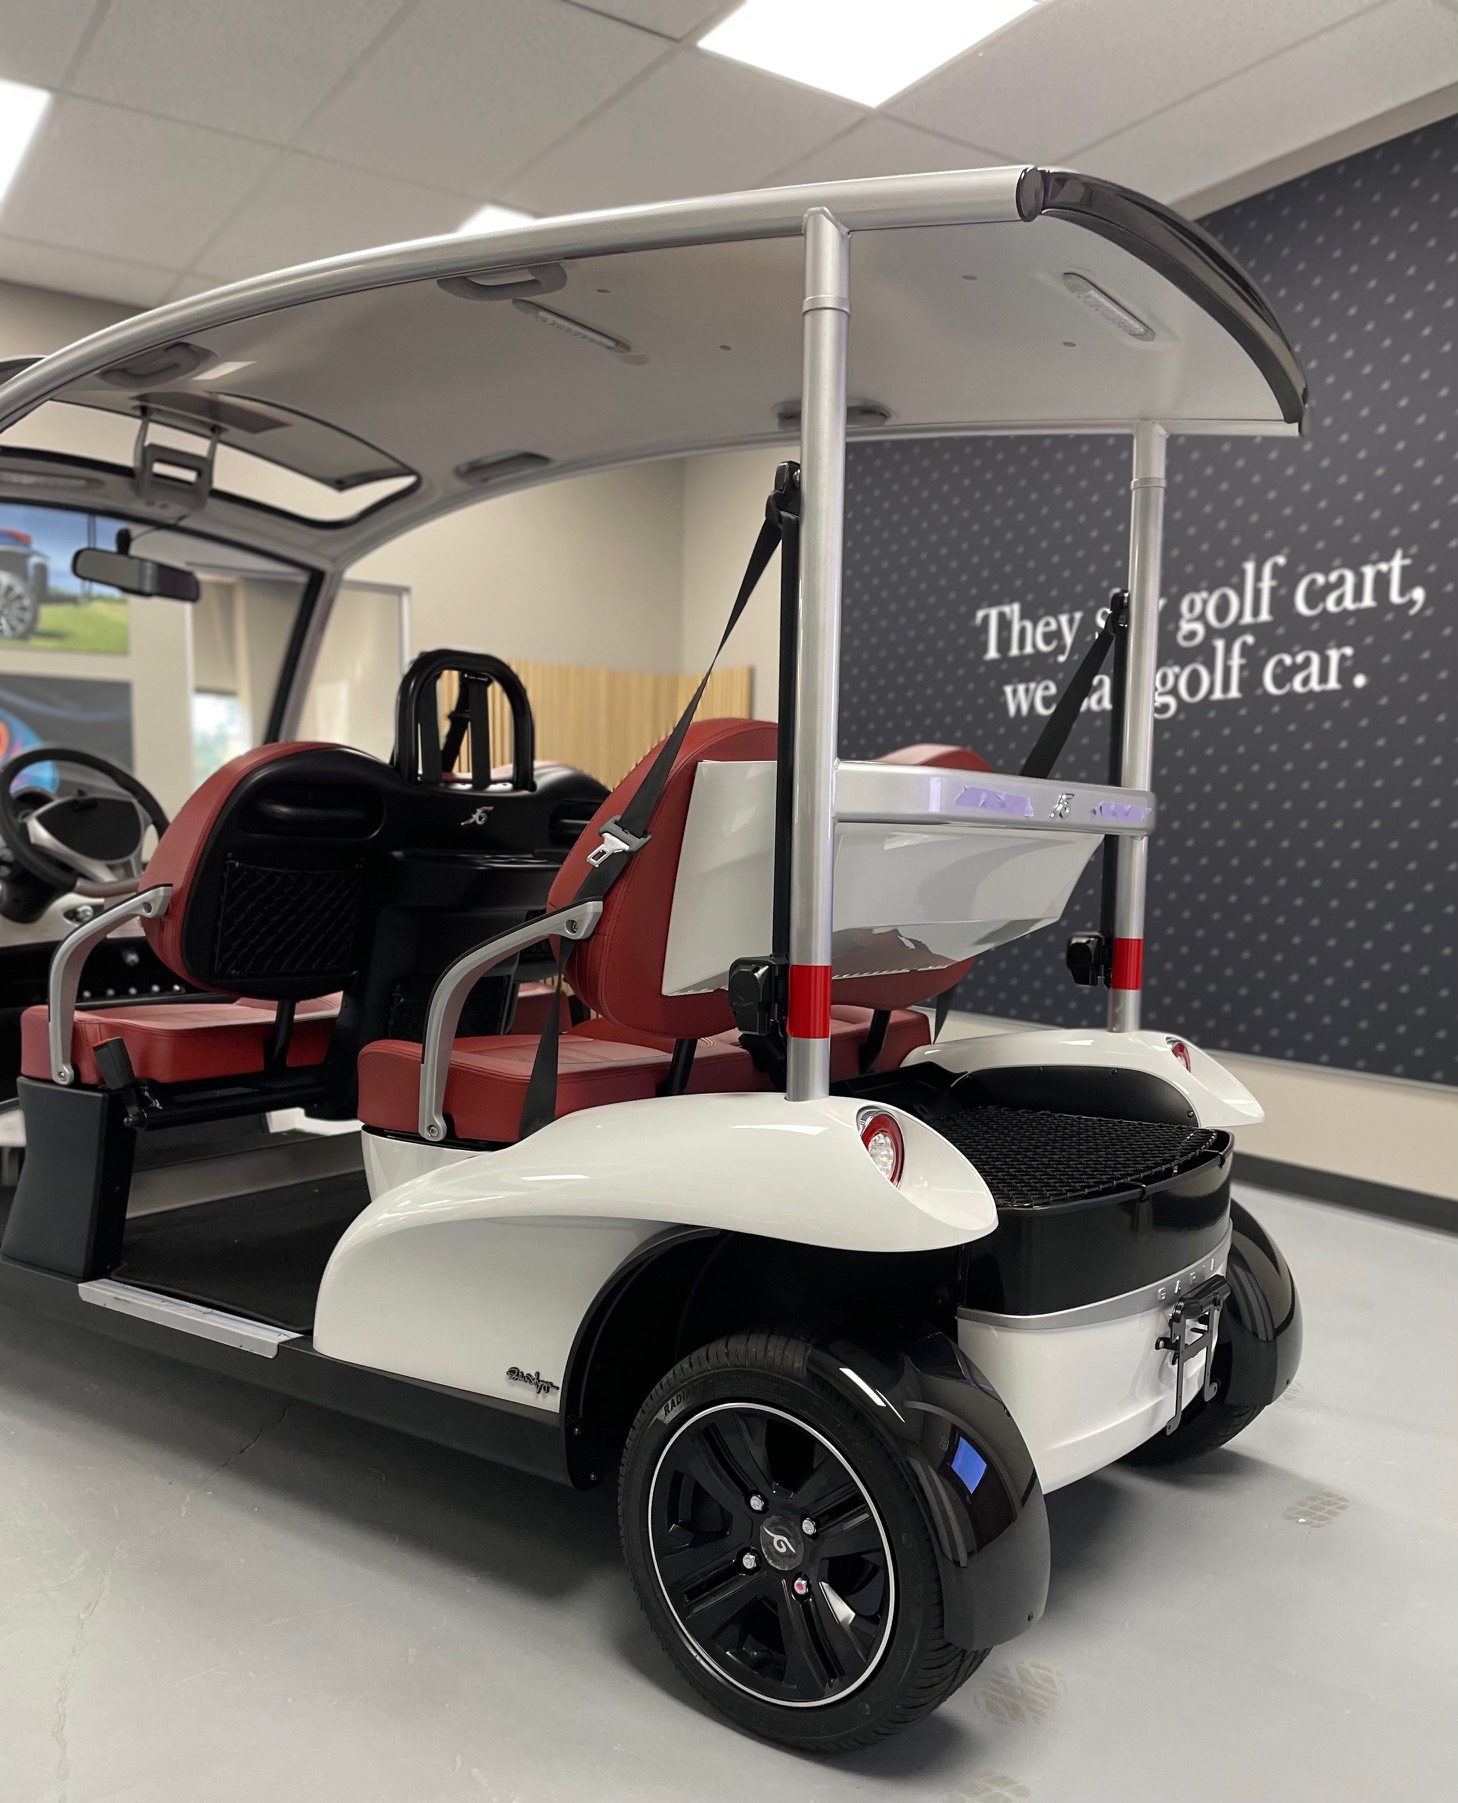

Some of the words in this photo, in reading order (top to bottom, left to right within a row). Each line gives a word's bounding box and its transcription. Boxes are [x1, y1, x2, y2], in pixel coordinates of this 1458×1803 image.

[975, 602, 1083, 663] They
[1177, 555, 1286, 648] golf
[1294, 548, 1426, 617] cart,
[1004, 679, 1058, 718] we
[1153, 634, 1255, 719] golf
[1262, 645, 1368, 696] car.
